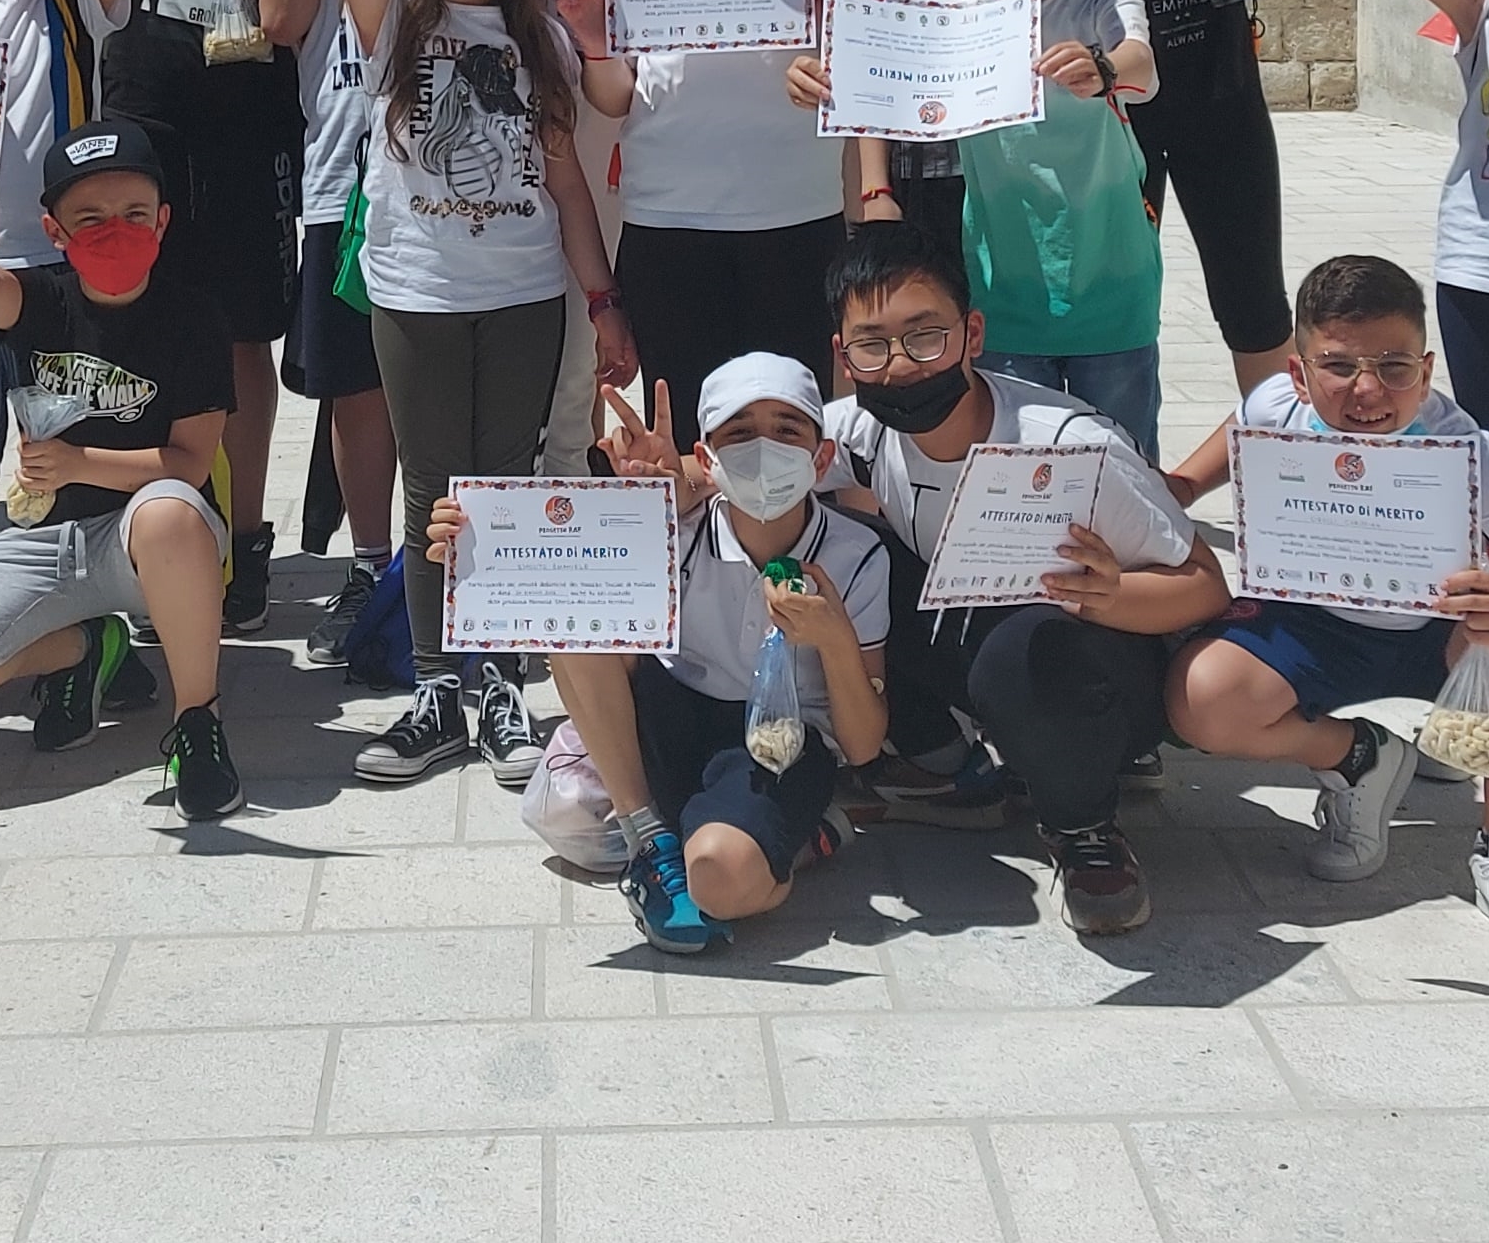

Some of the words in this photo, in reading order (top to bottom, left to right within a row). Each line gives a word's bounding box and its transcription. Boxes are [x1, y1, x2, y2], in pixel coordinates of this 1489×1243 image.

[1167, 30, 1205, 48] ALWAYS
[932, 65, 996, 83] ATTESTATO
[74, 138, 107, 153] VANS
[66, 356, 108, 386] VANS
[1284, 498, 1355, 514] ATTESTATO
[979, 510, 1032, 523] ATTESTATO
[494, 546, 563, 559] ATTESTATO
